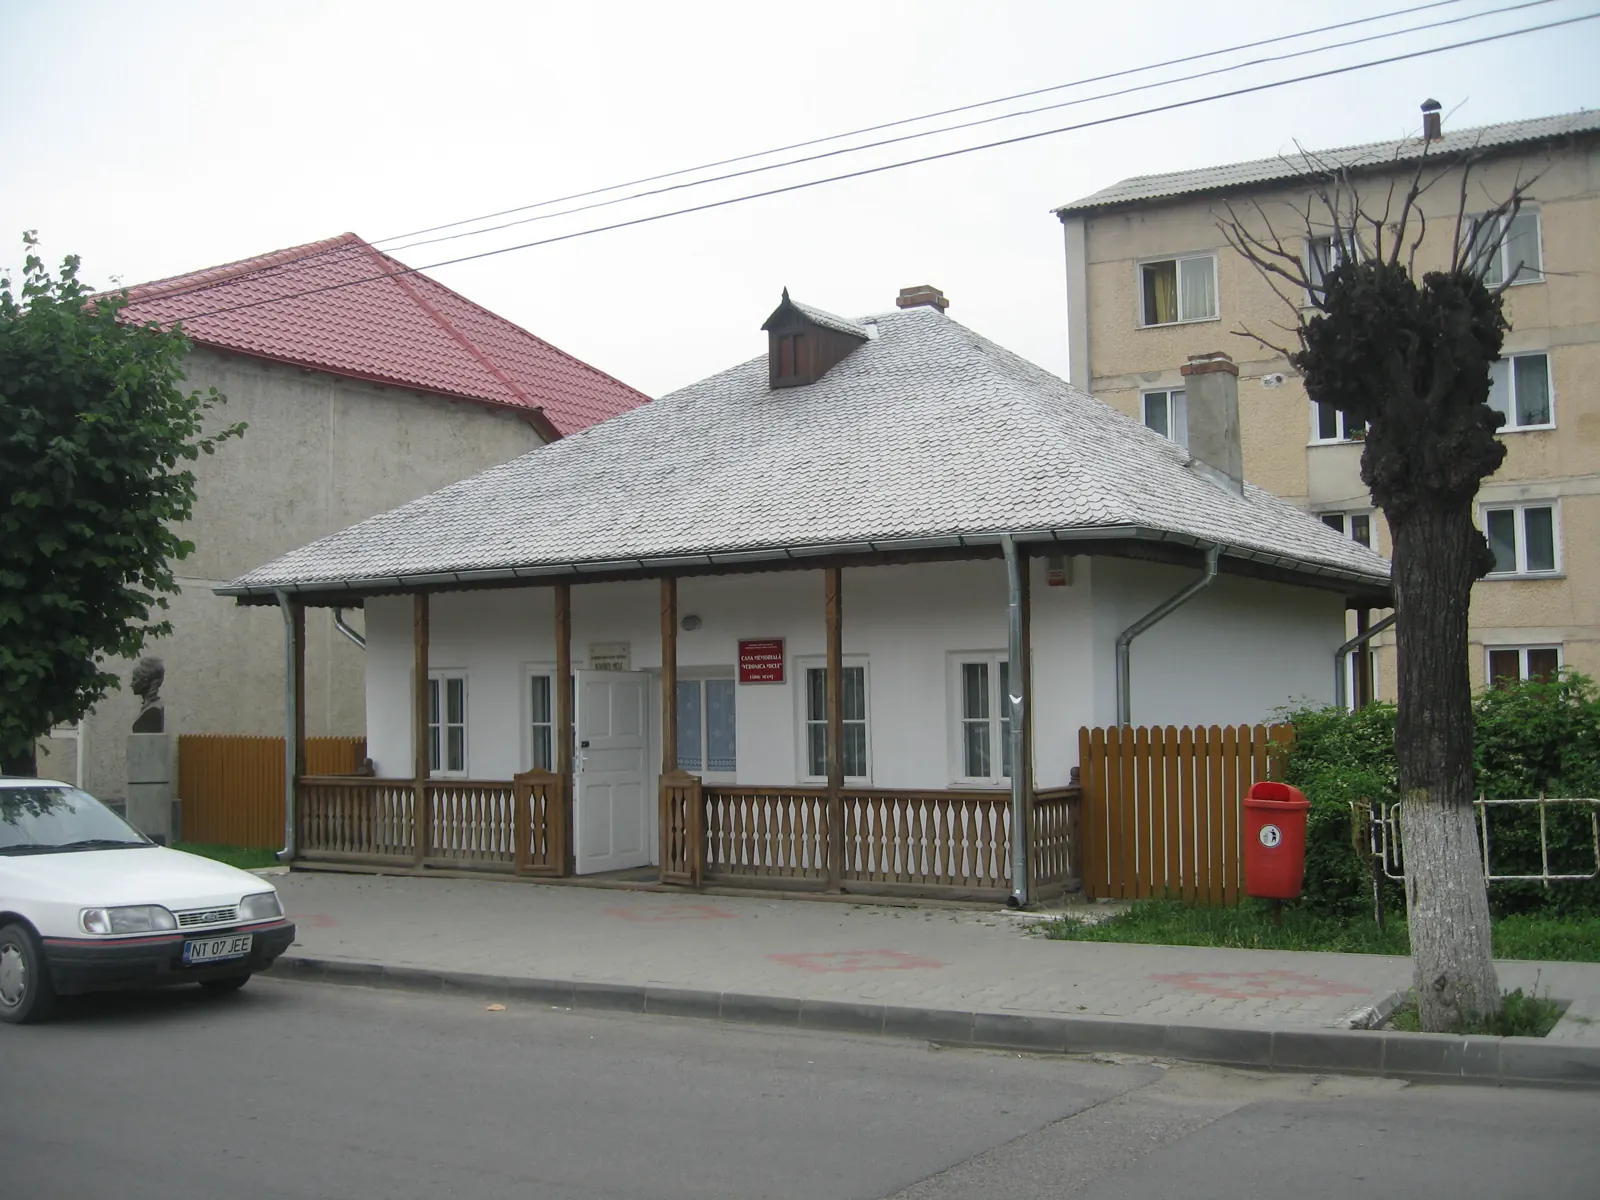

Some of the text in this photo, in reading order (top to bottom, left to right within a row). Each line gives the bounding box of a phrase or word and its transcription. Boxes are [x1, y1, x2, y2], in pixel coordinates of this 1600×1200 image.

[191, 937, 250, 958] NT 07 JEE
